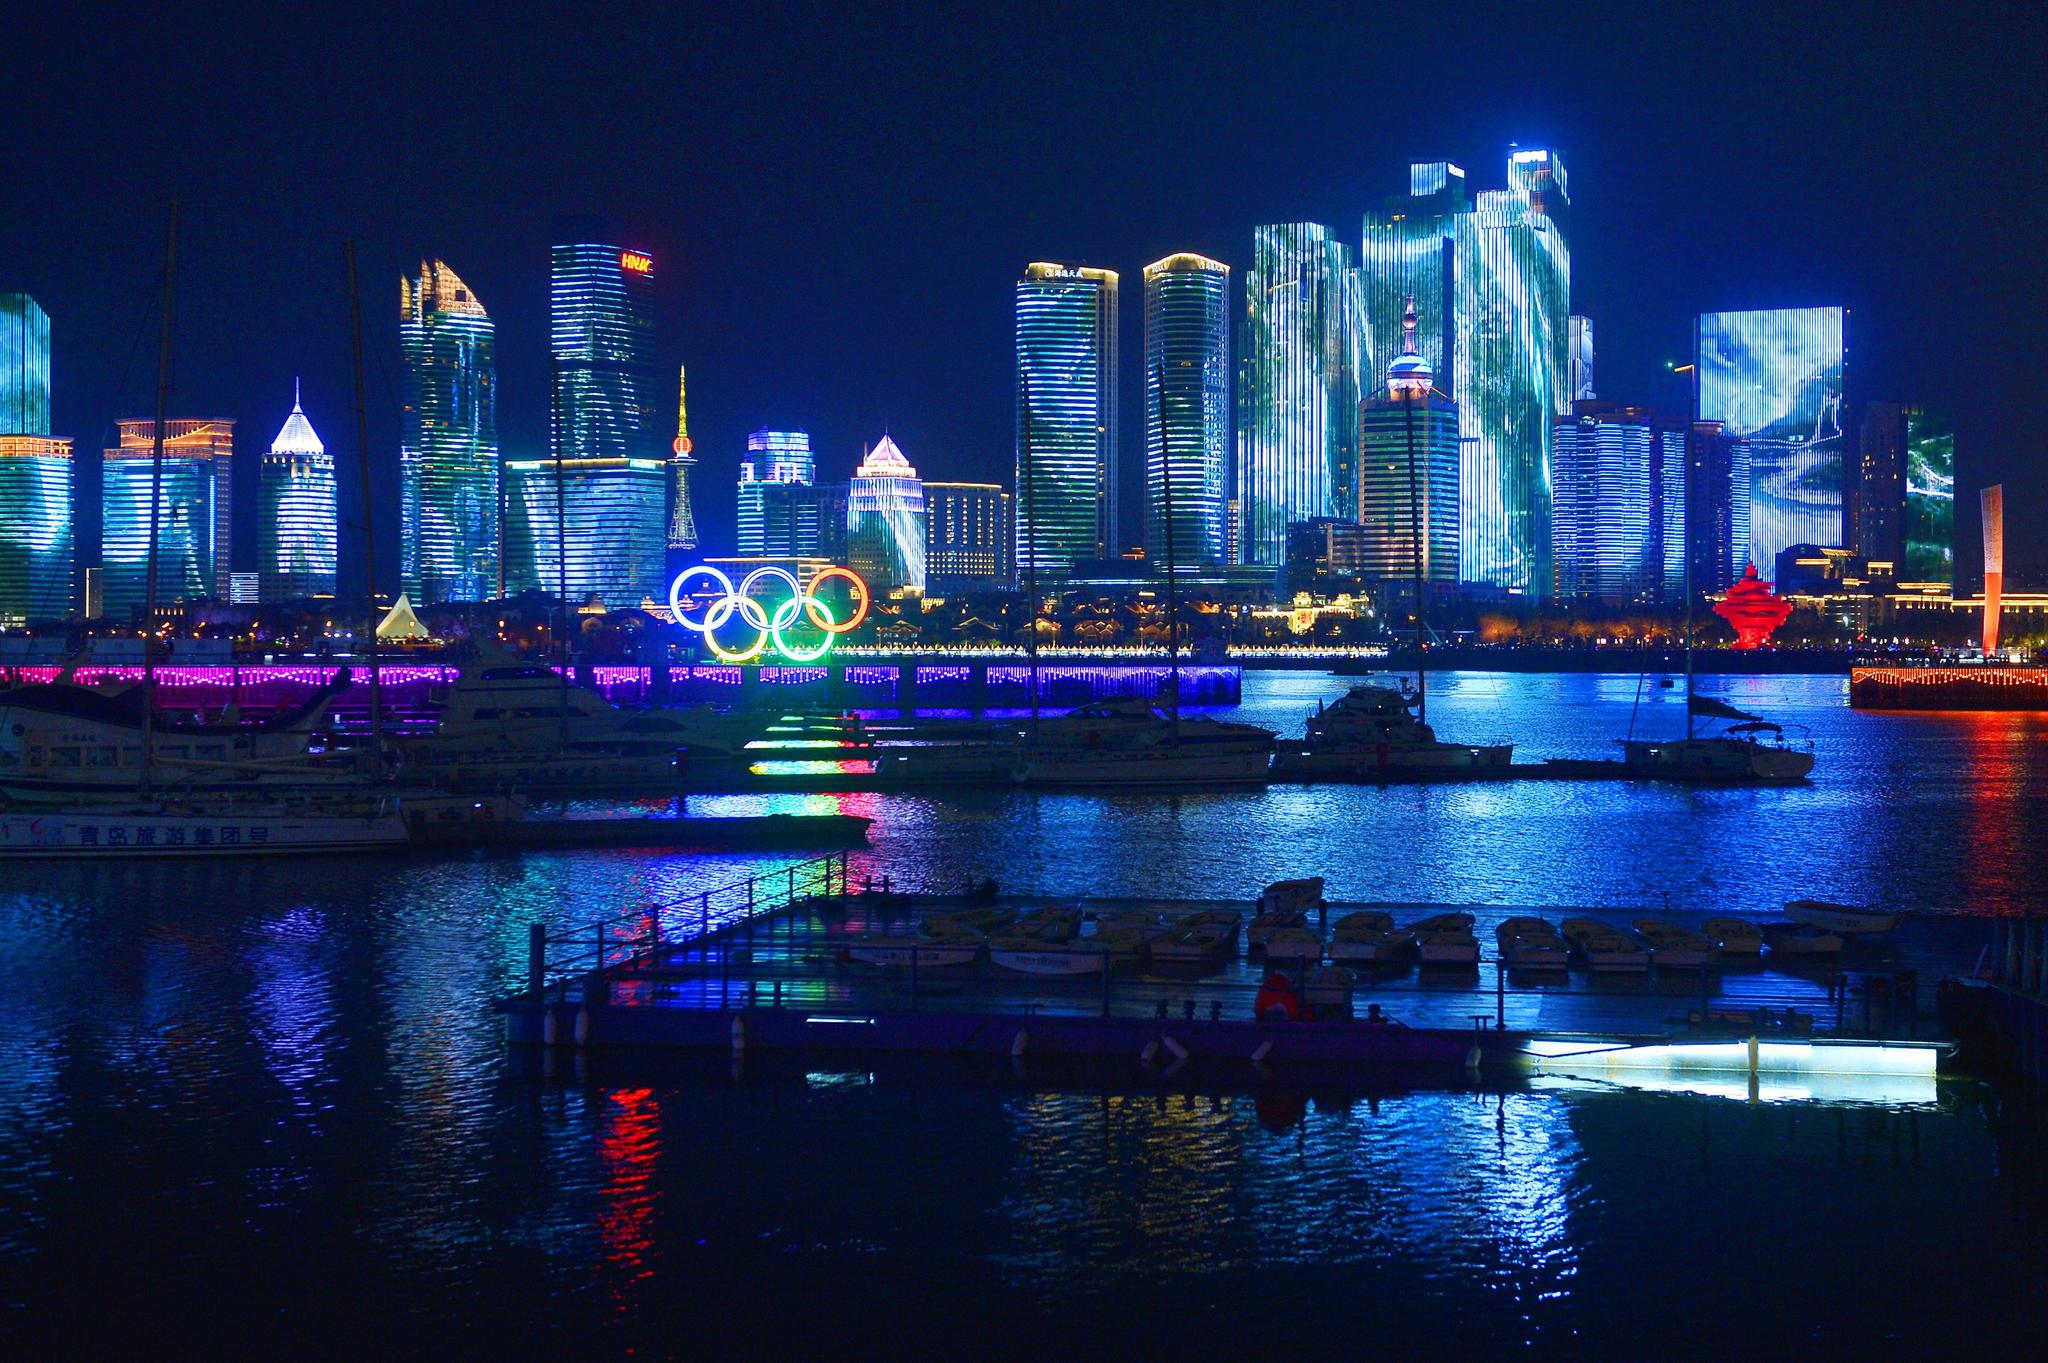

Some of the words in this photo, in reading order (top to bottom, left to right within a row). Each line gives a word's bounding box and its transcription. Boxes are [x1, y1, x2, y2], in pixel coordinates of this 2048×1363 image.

[79, 826, 269, 846] 青岛旅游集团号
